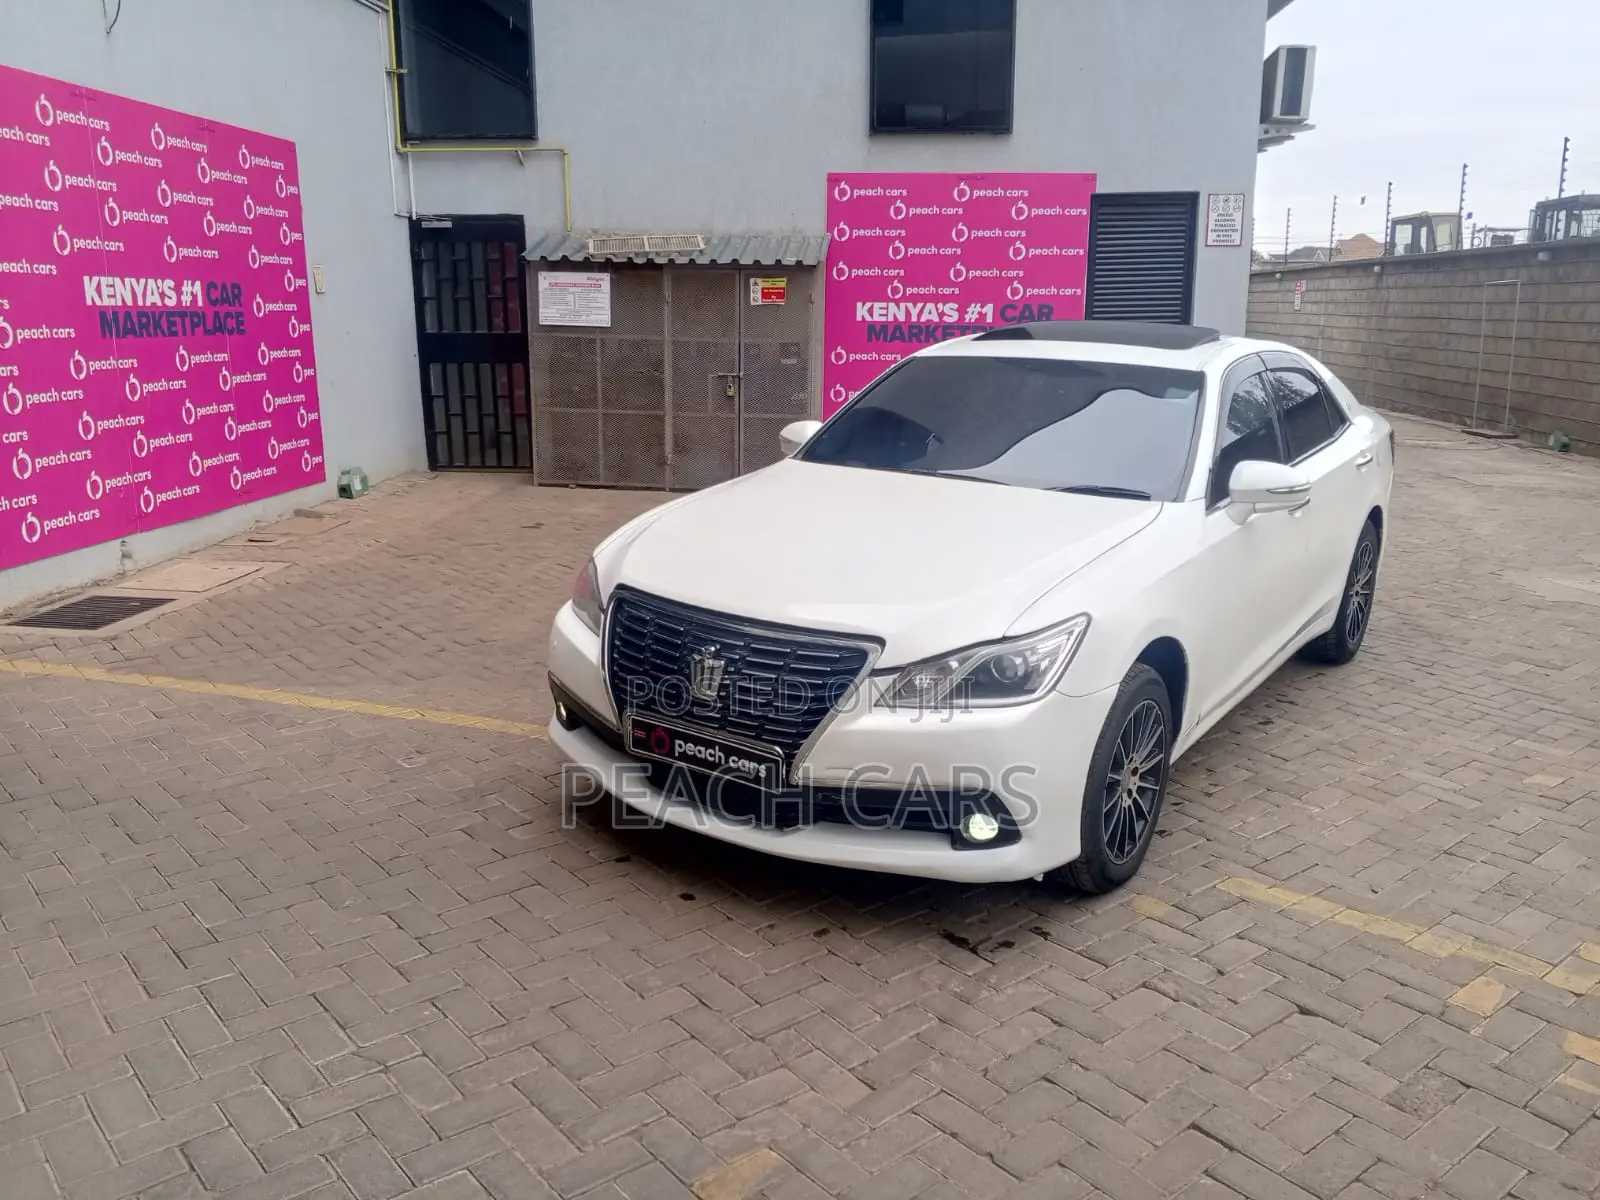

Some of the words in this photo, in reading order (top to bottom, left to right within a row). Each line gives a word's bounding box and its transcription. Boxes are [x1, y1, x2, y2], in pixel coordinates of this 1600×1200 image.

[56, 110, 88, 126] peach
[88, 116, 110, 131] cars
[26, 131, 50, 147] cars
[166, 136, 191, 149] peach
[191, 142, 207, 153] cars
[114, 150, 143, 164] peach
[143, 155, 163, 168] cars
[250, 156, 270, 167] peach
[271, 160, 284, 170] cars
[64, 174, 96, 189] peach
[96, 180, 117, 192] cars
[210, 169, 232, 182] peach
[233, 173, 248, 184] cars
[172, 192, 196, 204] peach
[197, 196, 214, 206] cars
[854, 186, 884, 198] peach
[973, 187, 1004, 199] peach
[34, 198, 59, 212] cars
[255, 204, 275, 216] peach
[275, 209, 288, 218] cars
[909, 205, 940, 217] peach
[1031, 206, 1062, 218] peach
[121, 209, 150, 224] peach
[150, 214, 168, 224] cars
[215, 221, 238, 235] peach
[238, 225, 252, 234] cars
[852, 227, 882, 239] peach
[971, 228, 1002, 240] peach
[72, 236, 102, 252] peach
[104, 239, 124, 252] cars
[908, 245, 938, 257] peach
[1029, 245, 1060, 258] peach
[178, 245, 202, 260] peach
[202, 249, 219, 259] cars
[259, 253, 280, 266] peach
[280, 256, 292, 264] cars
[32, 264, 57, 275] cars
[852, 266, 881, 278] peach
[968, 268, 1000, 280] peach
[181, 280, 203, 307] #1
[206, 282, 243, 307] CAR
[906, 285, 936, 296] peach
[1026, 286, 1058, 298] peach
[264, 300, 284, 314] peach
[964, 302, 994, 323] #1
[1000, 303, 1055, 323] CAR
[100, 309, 246, 339] MARKETPLACE
[15, 324, 51, 344] peach
[52, 328, 76, 338] cars
[190, 351, 213, 366] peach
[214, 352, 229, 363] cars
[268, 347, 288, 361] peach
[288, 348, 302, 357] cars
[850, 352, 878, 362] peach
[880, 354, 901, 362] cars
[87, 356, 118, 375] peach
[118, 357, 138, 369] cars
[141, 378, 168, 396] peach
[168, 380, 187, 390] cars
[231, 371, 252, 388] peach
[252, 372, 267, 382] cars
[25, 387, 59, 409] peach
[60, 389, 84, 401] cars
[273, 393, 292, 408] peach
[292, 393, 306, 403] cars
[196, 402, 219, 420] peach
[219, 403, 234, 413] cars
[96, 414, 125, 435] peach
[125, 415, 145, 426] cars
[236, 420, 258, 436] peach
[258, 420, 272, 429] cars
[2, 430, 28, 443] cars
[148, 432, 175, 452] peach
[175, 432, 193, 444] cars
[278, 438, 297, 455] peach
[297, 438, 310, 448] cars
[34, 450, 68, 472] peach
[69, 449, 92, 462] cars
[202, 453, 224, 472] peach
[224, 452, 240, 462] cars
[104, 472, 133, 490] peach
[133, 470, 152, 482] cars
[241, 467, 263, 484] peach
[263, 466, 277, 476] cars
[11, 494, 38, 508] cars
[156, 486, 182, 507] peach
[182, 484, 200, 496] cars
[43, 510, 76, 535] peach
[77, 508, 100, 522] cars
[674, 739, 725, 764] peach
[728, 756, 767, 778] cars
